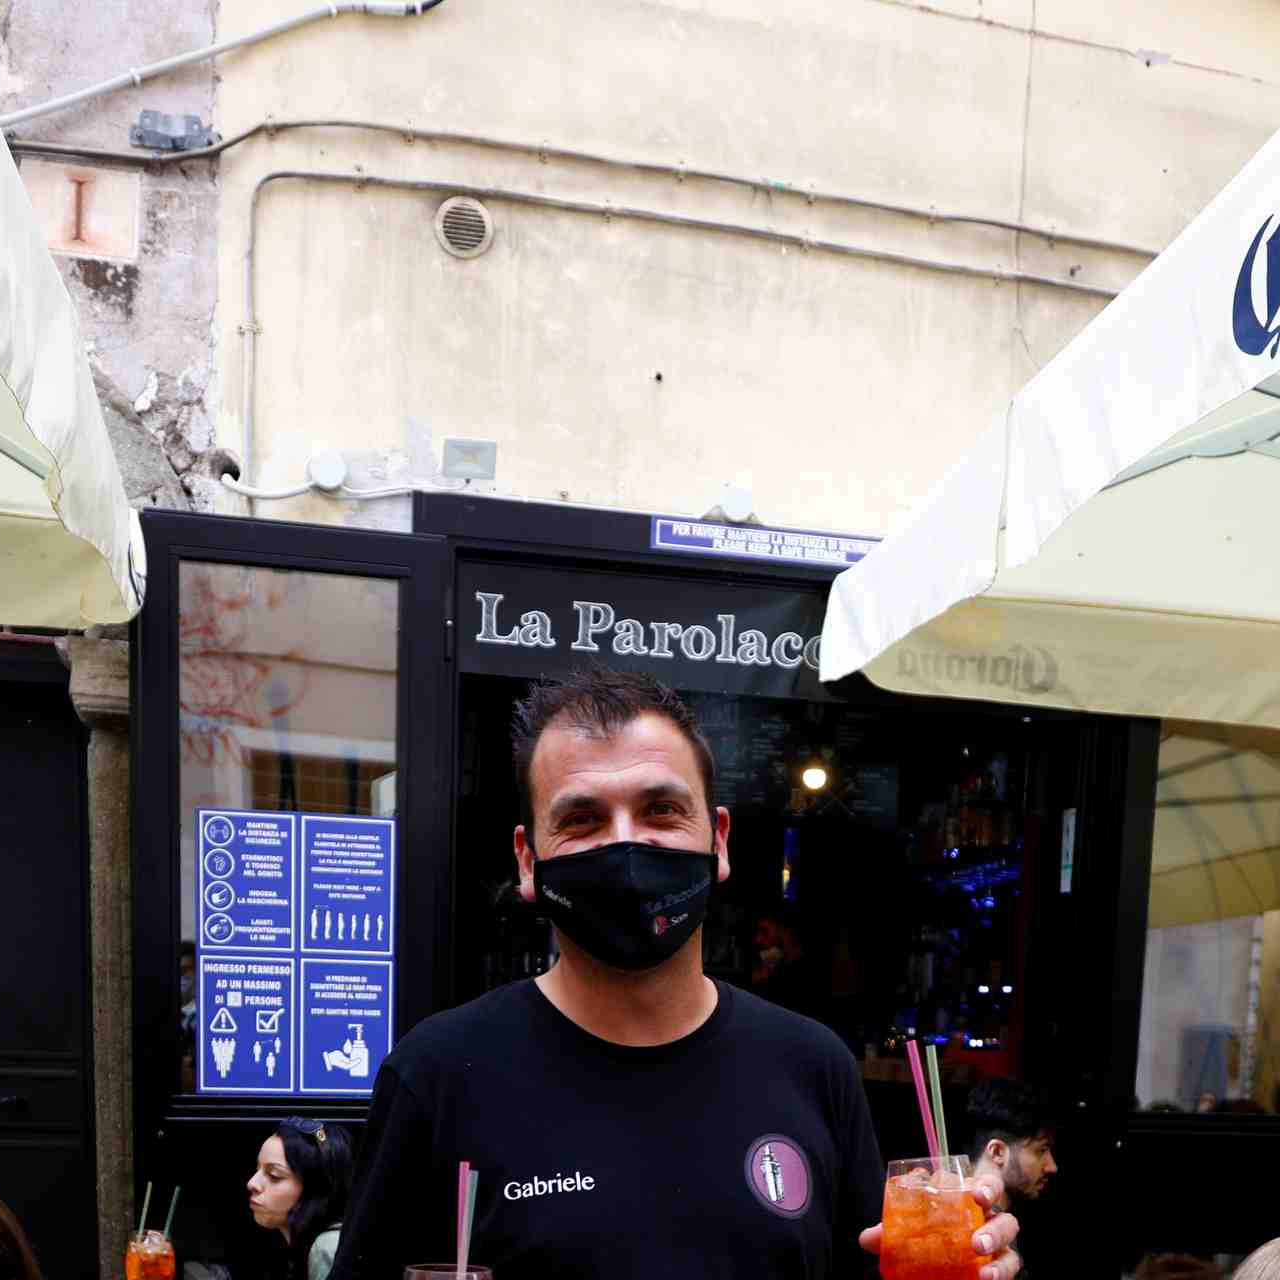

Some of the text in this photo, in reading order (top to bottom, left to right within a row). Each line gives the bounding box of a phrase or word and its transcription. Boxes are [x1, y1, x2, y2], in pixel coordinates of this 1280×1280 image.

[475, 591, 556, 649] La
[204, 963, 290, 975] INGRESSO PERMESSO
[216, 979, 281, 990] AD UN MASSIMO
[215, 995, 224, 1003] DI
[245, 996, 282, 1005] PERSONE
[503, 1171, 595, 1201] Gabriele
